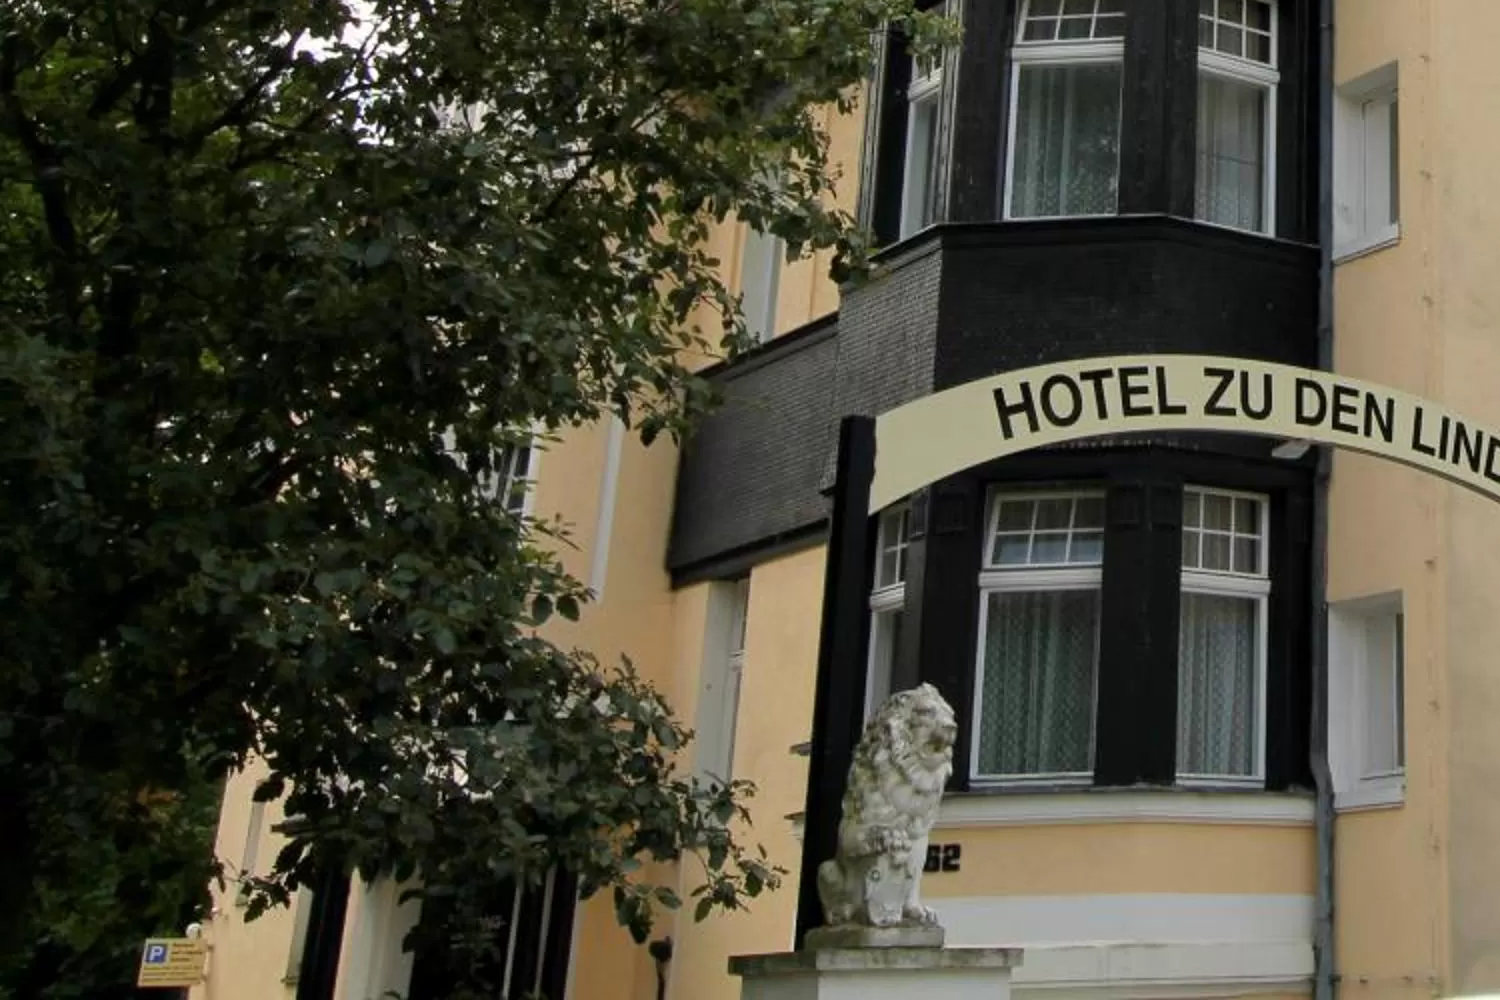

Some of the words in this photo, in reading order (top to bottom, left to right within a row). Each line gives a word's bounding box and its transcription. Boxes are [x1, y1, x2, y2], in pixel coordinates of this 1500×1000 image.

[992, 365, 1187, 441] HOTEL
[1203, 366, 1273, 421] ZU
[1295, 377, 1395, 444] DEN
[148, 945, 164, 961] P
